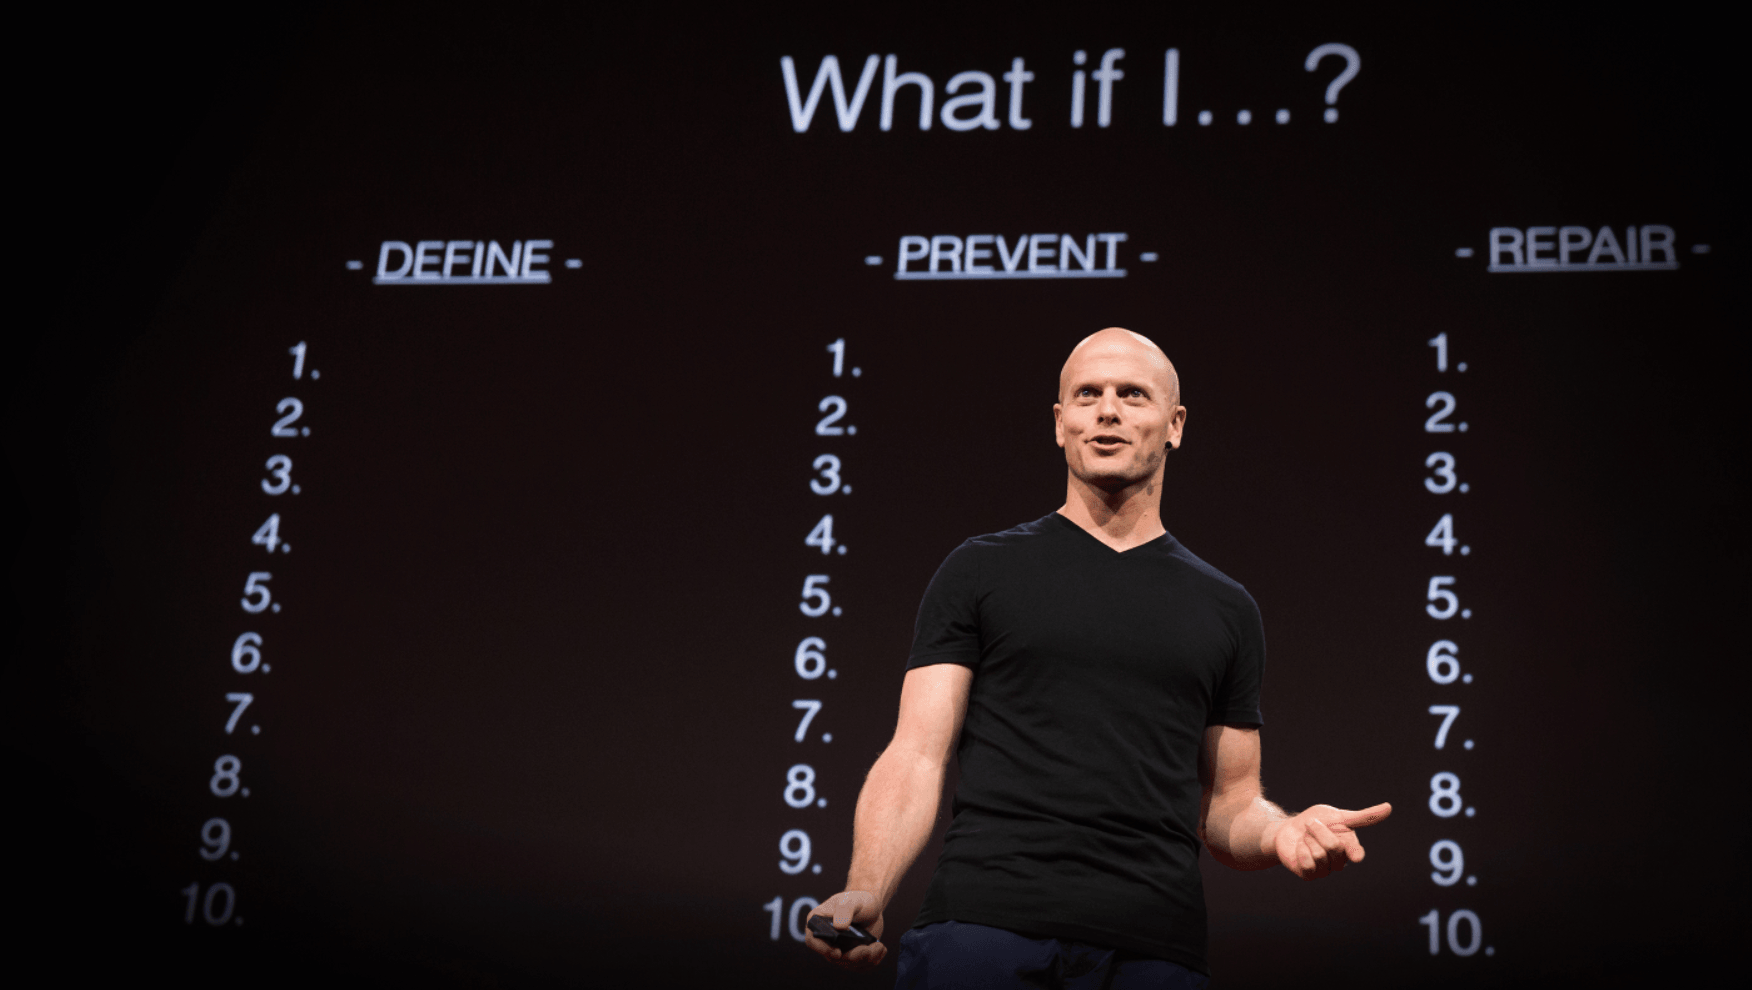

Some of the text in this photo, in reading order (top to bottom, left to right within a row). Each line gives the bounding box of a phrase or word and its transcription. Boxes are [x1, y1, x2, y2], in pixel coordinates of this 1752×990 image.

[779, 52, 1035, 134] What
[1070, 47, 1125, 128] if
[373, 239, 554, 286] DEFINE
[894, 232, 1129, 281] PREVENT
[1487, 225, 1679, 274] REPAIR
[289, 340, 321, 380] 1.
[826, 337, 862, 378] 1.
[1428, 332, 1468, 373] 1.
[270, 396, 311, 437] 2.
[814, 394, 858, 437] 2.
[1424, 390, 1469, 433] 2.
[260, 454, 301, 496] 3.
[809, 453, 853, 496] 3.
[1423, 451, 1470, 495] 3.
[251, 512, 291, 555] 4.
[804, 513, 848, 556] 4.
[1424, 512, 1471, 556] 4.
[240, 571, 281, 614] 5.
[798, 573, 843, 618] 5.
[1425, 575, 1473, 621] 5.
[230, 631, 272, 674] 6.
[793, 635, 838, 681] 6.
[1425, 638, 1473, 686] 6.
[224, 692, 261, 736] 7.
[791, 698, 833, 744] 7.
[1427, 704, 1475, 751] 7.
[210, 754, 251, 799] 8.
[782, 763, 828, 810] 8.
[1427, 770, 1477, 819] 8.
[198, 816, 240, 862] 9.
[778, 828, 823, 876] 9.
[1428, 838, 1478, 887] 9.
[181, 881, 244, 926] 10.
[1419, 909, 1495, 957] 10.
